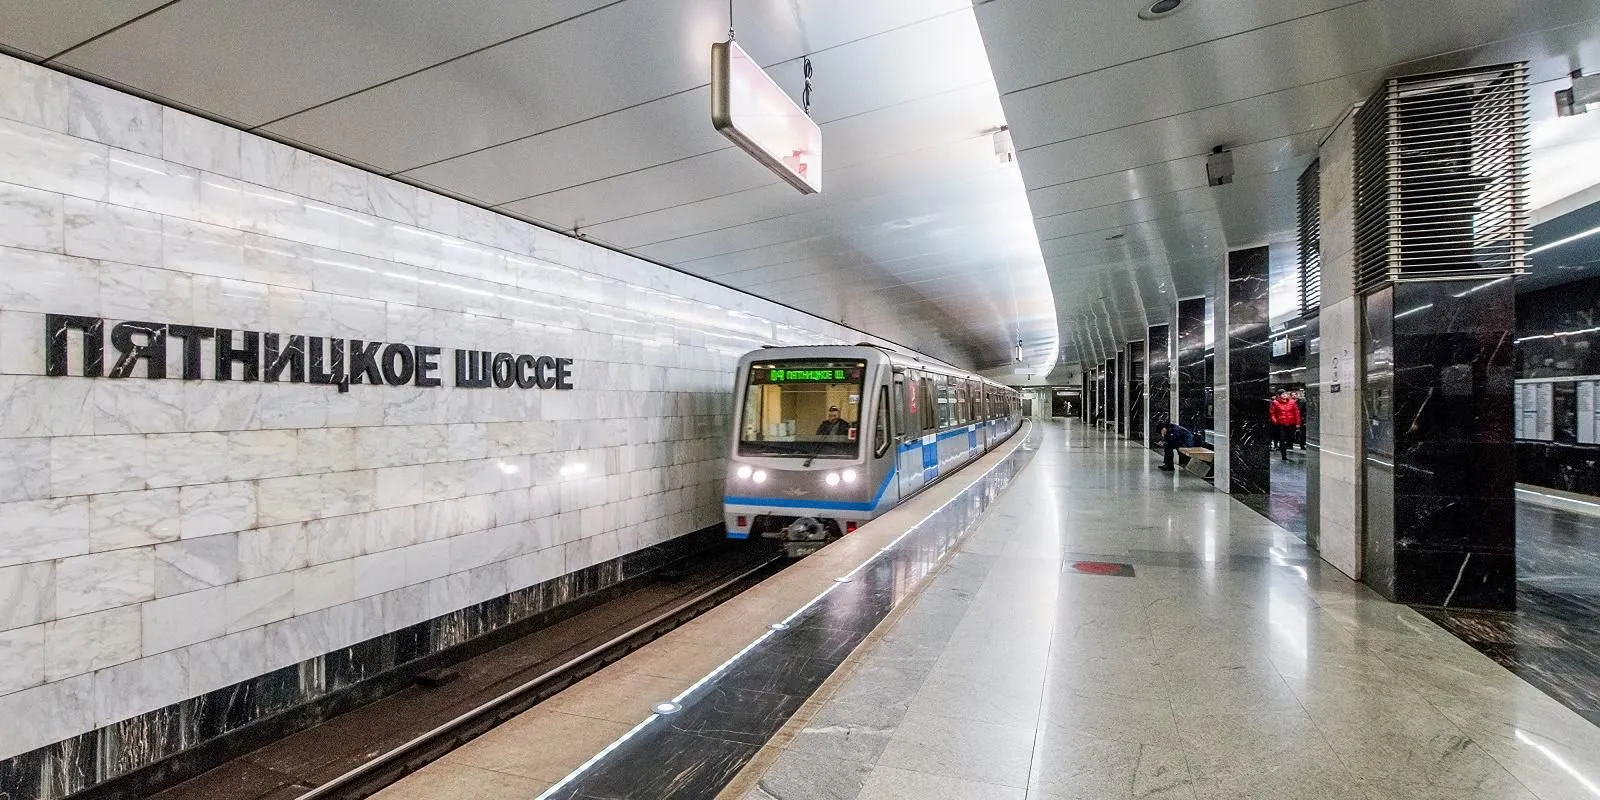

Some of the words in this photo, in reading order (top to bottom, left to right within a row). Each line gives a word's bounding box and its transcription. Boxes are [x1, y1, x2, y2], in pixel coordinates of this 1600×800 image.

[45, 313, 441, 392] ПЯТНИЦКОЕ
[455, 349, 574, 390] ШОССЕ
[786, 370, 833, 380] ПЯТНИЦКОЕ
